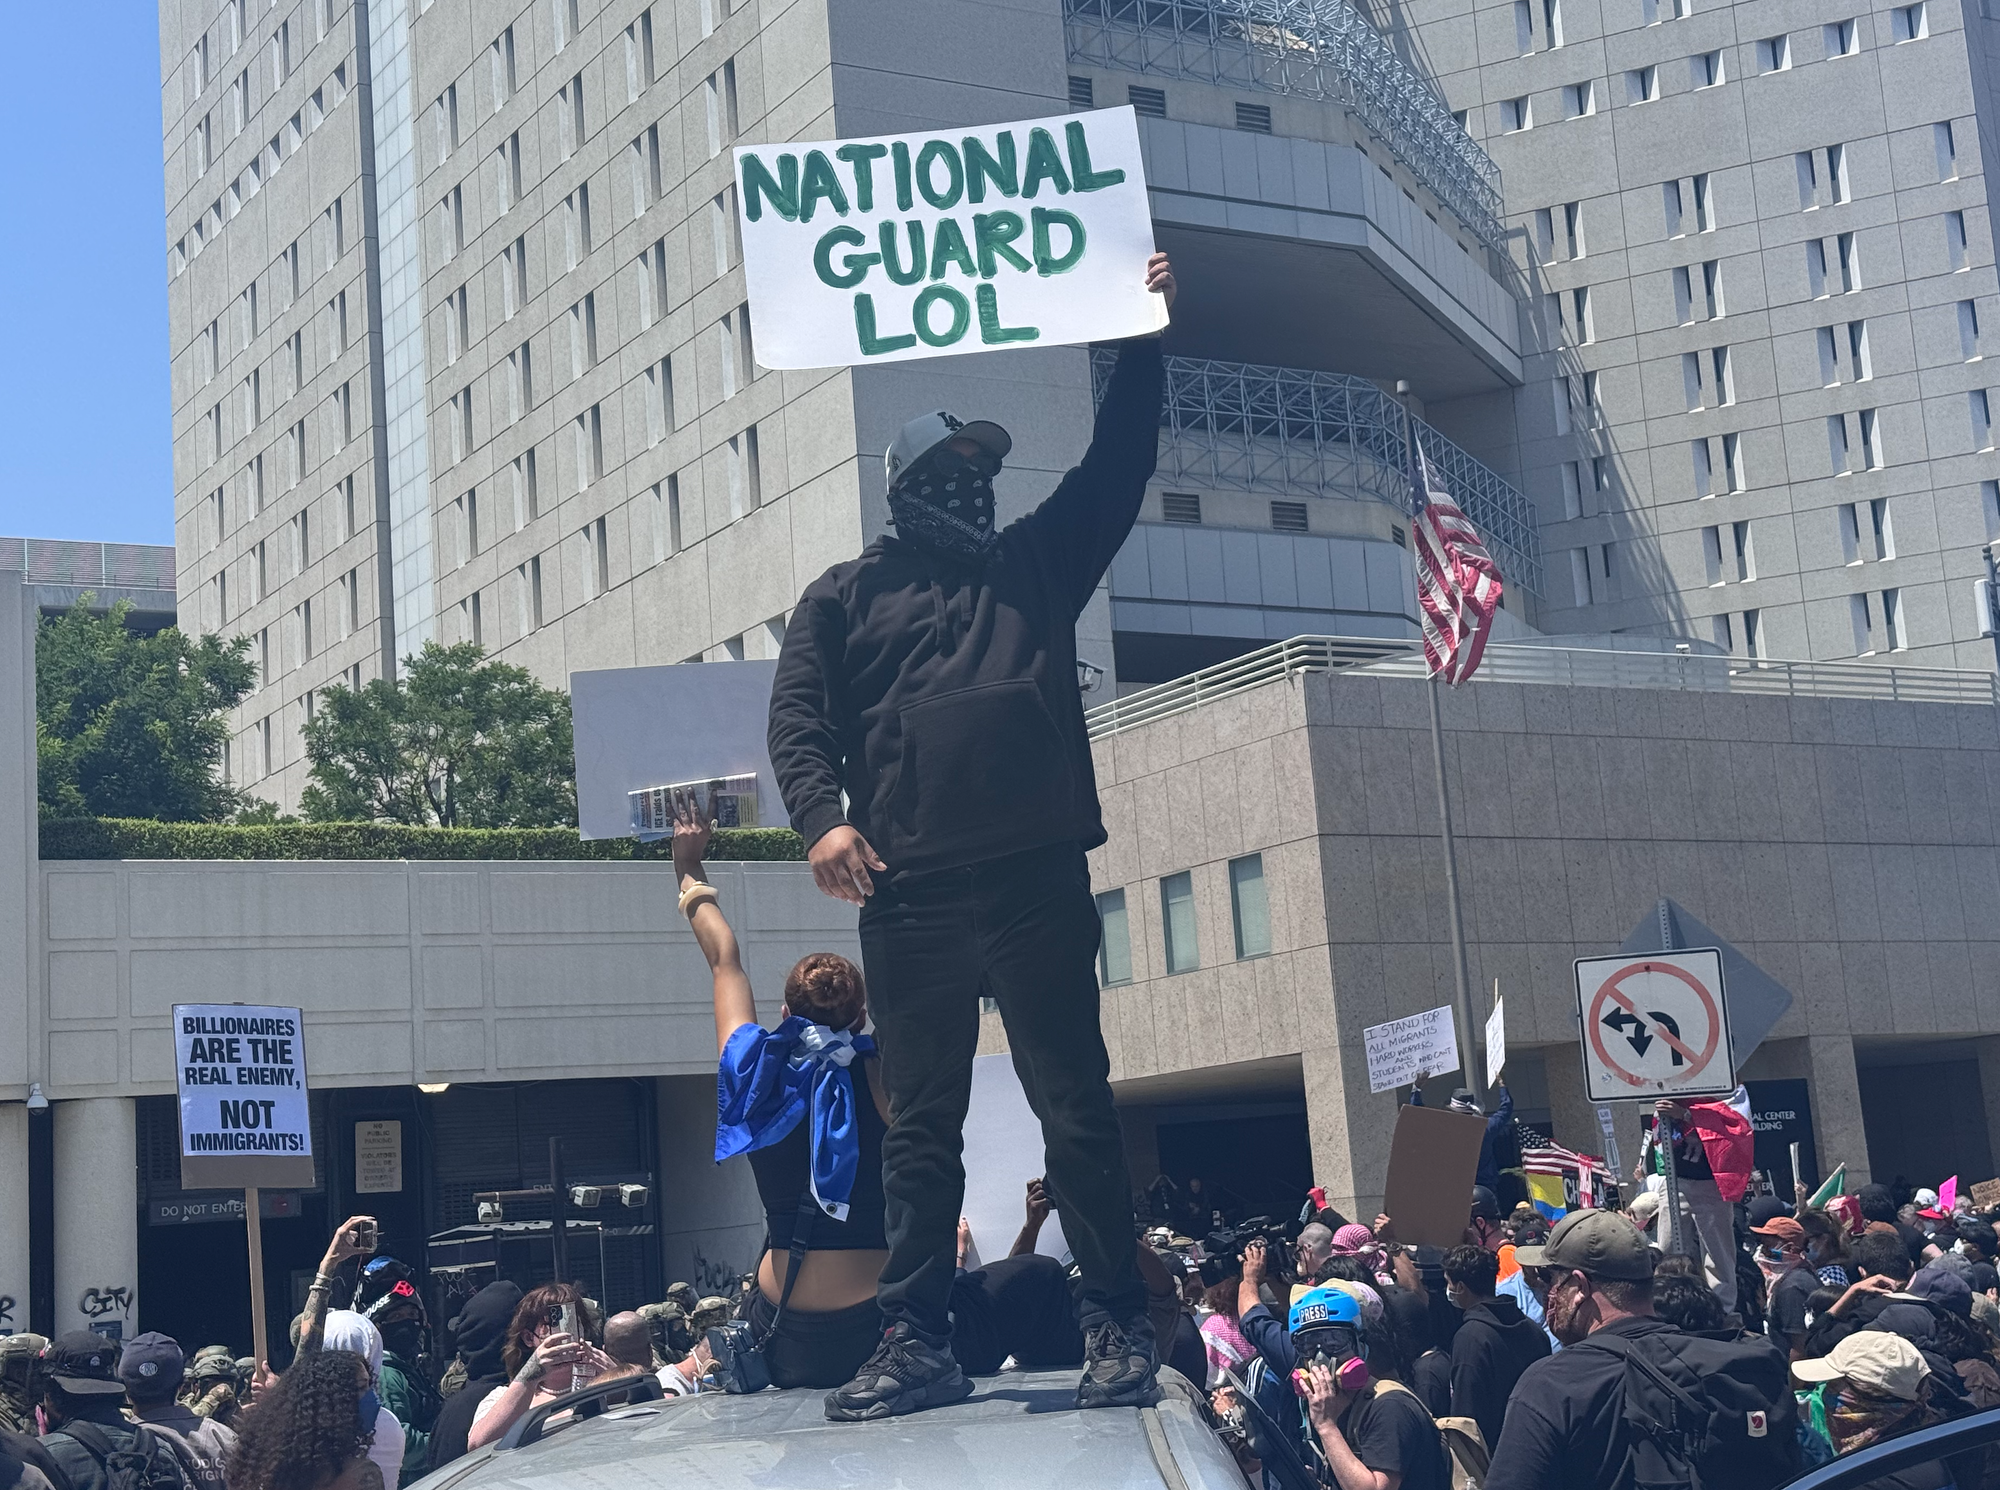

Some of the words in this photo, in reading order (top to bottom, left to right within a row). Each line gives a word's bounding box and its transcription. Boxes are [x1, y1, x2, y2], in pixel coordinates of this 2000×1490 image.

[740, 121, 1126, 223] NATIONAL
[813, 206, 1087, 289] GUARD
[854, 283, 1041, 356] LOL
[937, 411, 964, 431] LA
[654, 798, 663, 816] raids
[655, 817, 663, 828] ICE
[183, 1017, 295, 1036] BILLIONAIRES
[1365, 1029, 1377, 1040] I
[1381, 1018, 1420, 1038] STAND
[1422, 1010, 1440, 1025] FOR
[1368, 1042, 1385, 1053] ALL
[1389, 1026, 1437, 1047] MIGRANTS
[189, 1038, 242, 1063] ARE
[247, 1039, 293, 1064] THE
[1370, 1051, 1396, 1066] HARD
[1397, 1040, 1434, 1056] WORKERS
[1395, 1054, 1412, 1064] AND
[184, 1067, 232, 1085] REAL
[237, 1067, 300, 1090] ENEMY,
[1371, 1060, 1417, 1080] STUDENTS
[220, 1100, 275, 1129] NOT
[1765, 1111, 1796, 1120] CENTER
[190, 1133, 304, 1151] IMMIGRANTS!
[161, 1206, 178, 1216] DO
[184, 1204, 207, 1215] NOT
[79, 1286, 134, 1320] CITY
[1300, 1304, 1326, 1322] PRESS
